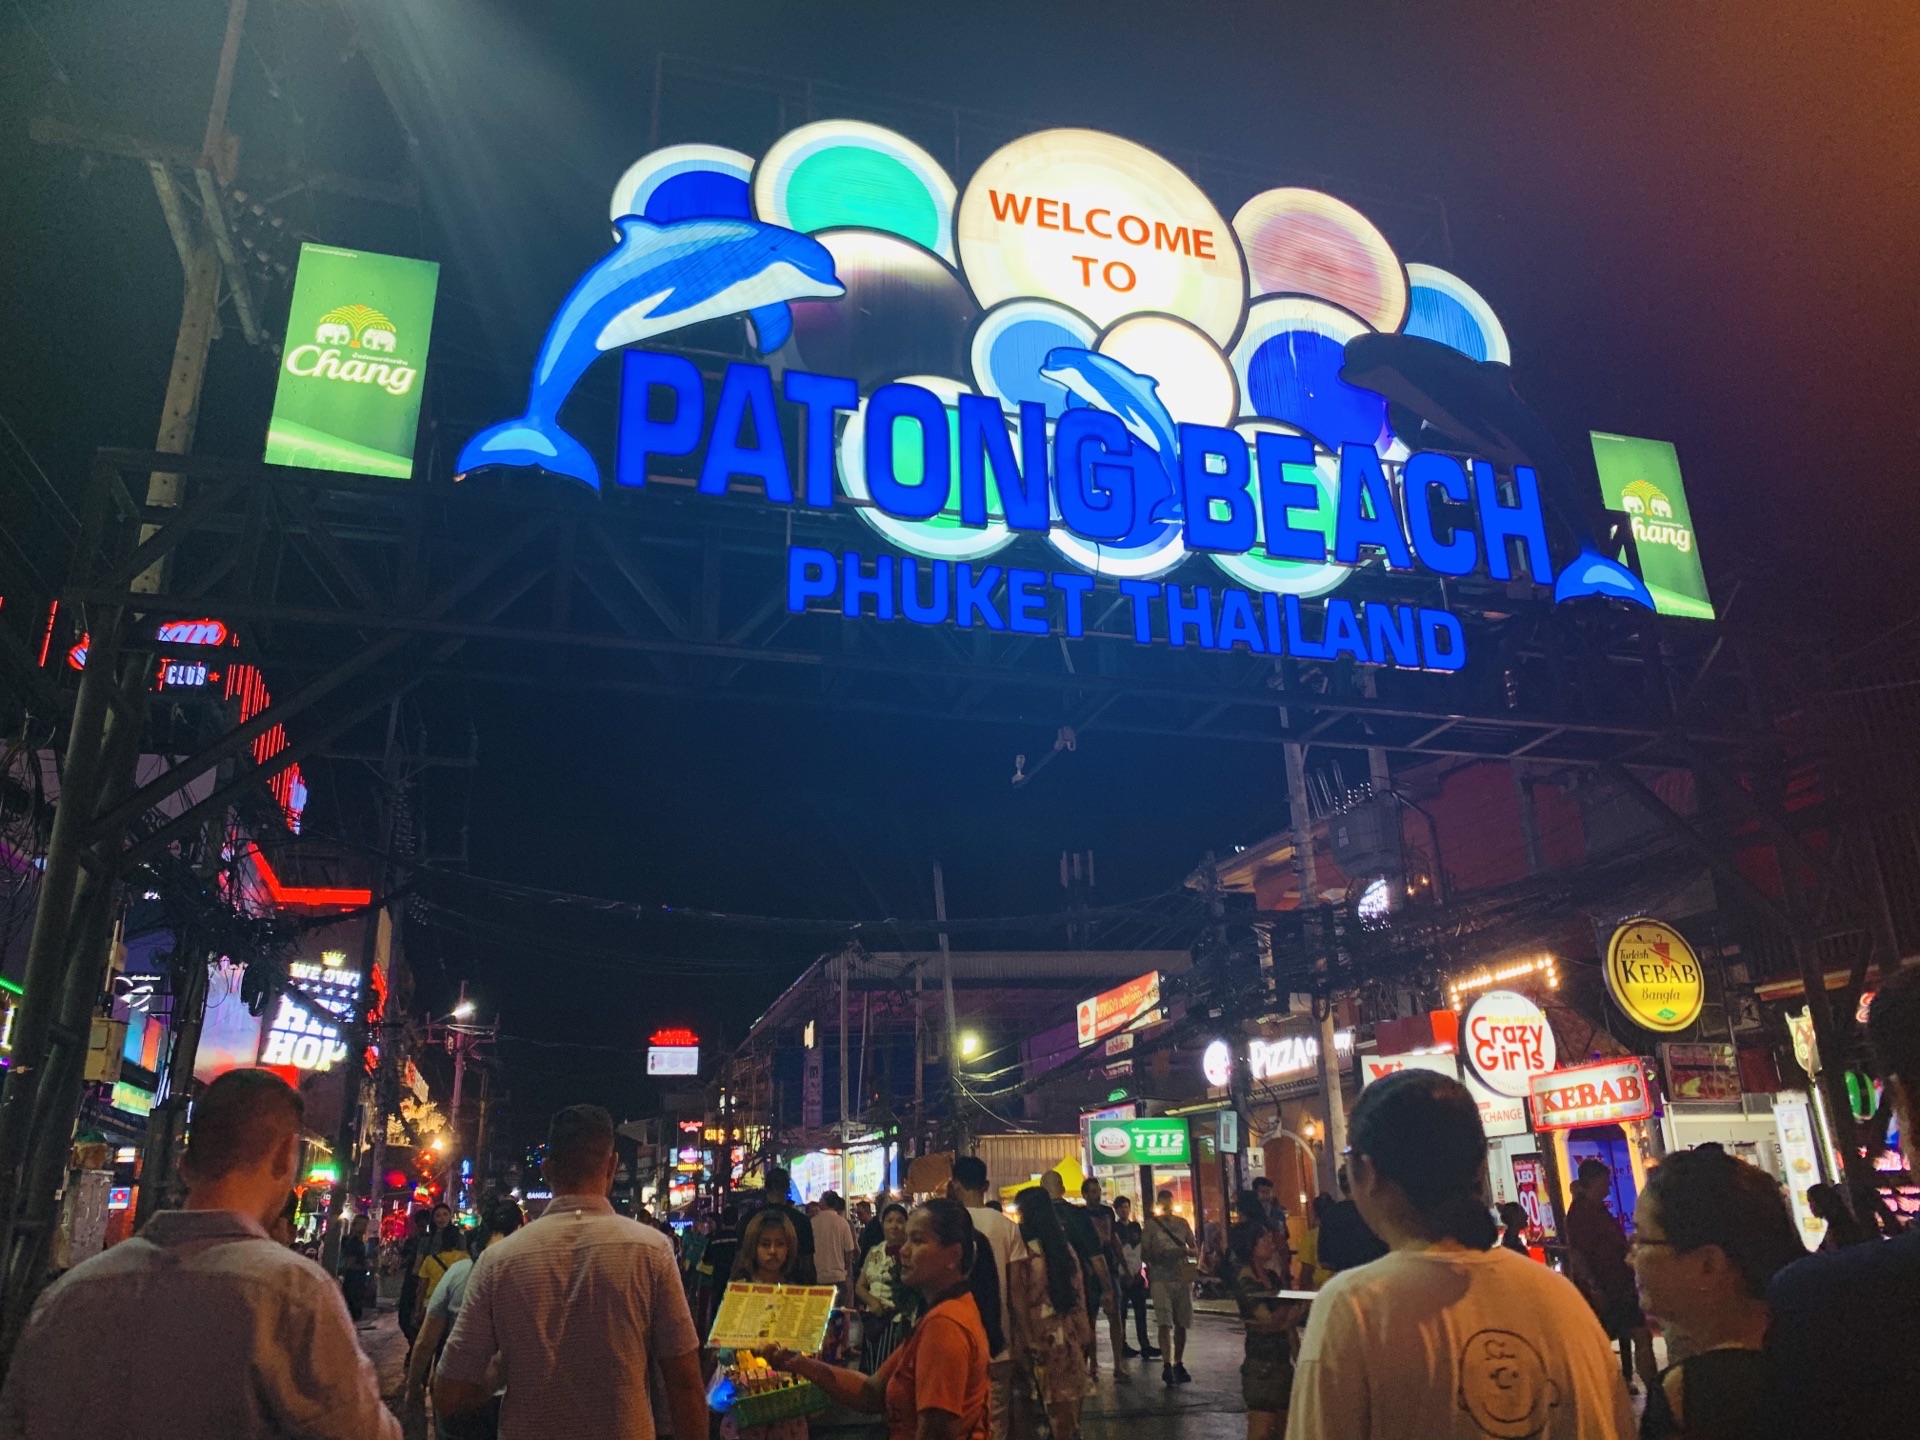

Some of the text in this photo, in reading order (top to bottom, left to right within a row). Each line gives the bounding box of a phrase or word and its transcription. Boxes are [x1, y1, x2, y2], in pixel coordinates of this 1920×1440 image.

[988, 189, 1217, 261] WELCOME
[1072, 255, 1137, 293] TO
[285, 344, 418, 395] Chang
[615, 347, 1556, 587] PATONG BEACH
[1631, 516, 1692, 553] hang
[786, 545, 1468, 673] PHUKET THAILAND
[166, 664, 206, 686] CLUB
[1620, 949, 1649, 961] Turkish
[1621, 960, 1697, 984] KEBAB
[1641, 987, 1681, 1004] Bangla
[1471, 1016, 1544, 1053] Crazy
[1488, 1016, 1511, 1024] Rock
[261, 1030, 348, 1071] HOP
[1249, 1037, 1309, 1079] PIZZA
[1475, 1040, 1546, 1071] Girls
[1539, 1076, 1641, 1113] KEBAB
[1101, 1135, 1125, 1144] PIZZA
[1134, 1133, 1185, 1148] 1112
[1516, 1170, 1534, 1184] LEO
